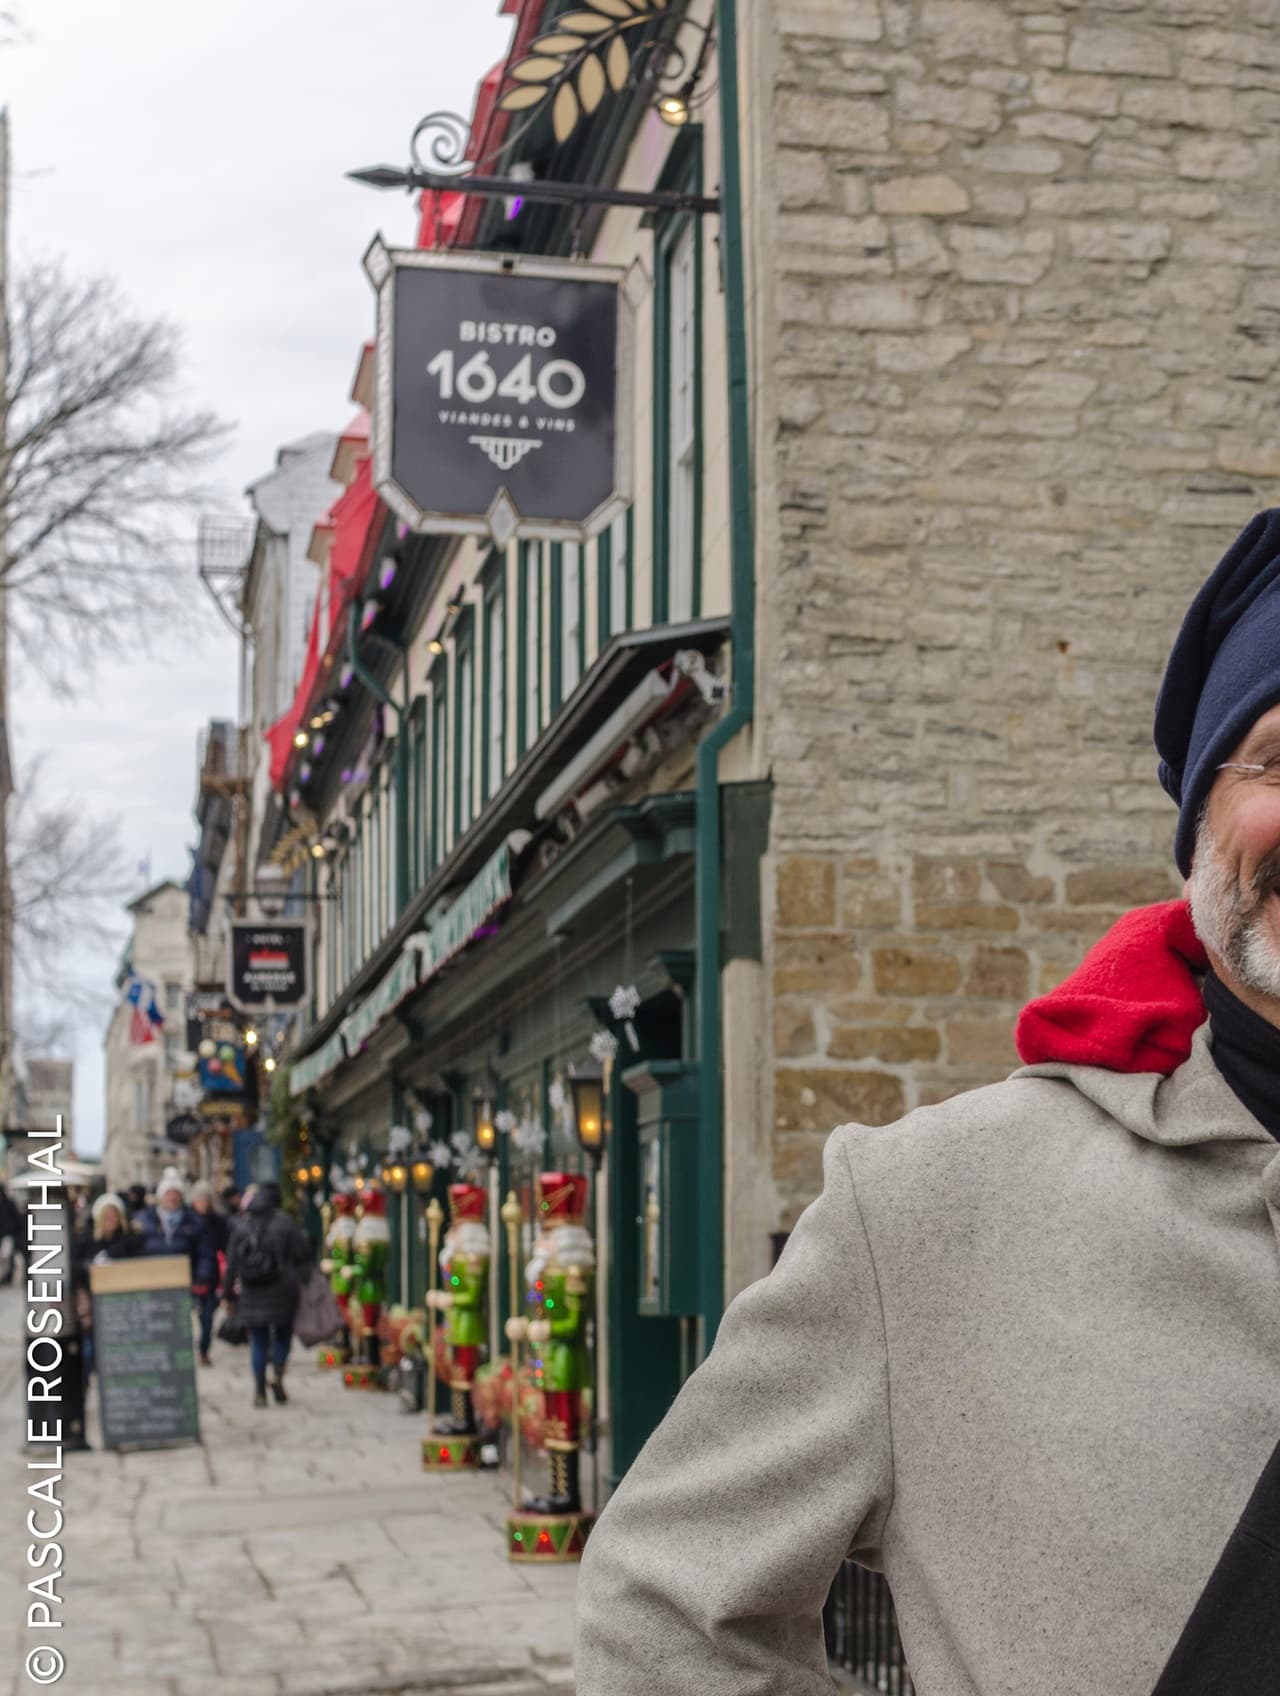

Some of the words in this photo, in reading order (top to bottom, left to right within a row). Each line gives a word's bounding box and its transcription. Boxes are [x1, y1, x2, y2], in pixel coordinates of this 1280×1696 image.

[459, 320, 557, 347] BISTRO
[426, 349, 586, 409] 1640
[438, 410, 512, 428] VIANDES
[536, 417, 576, 433] VINS
